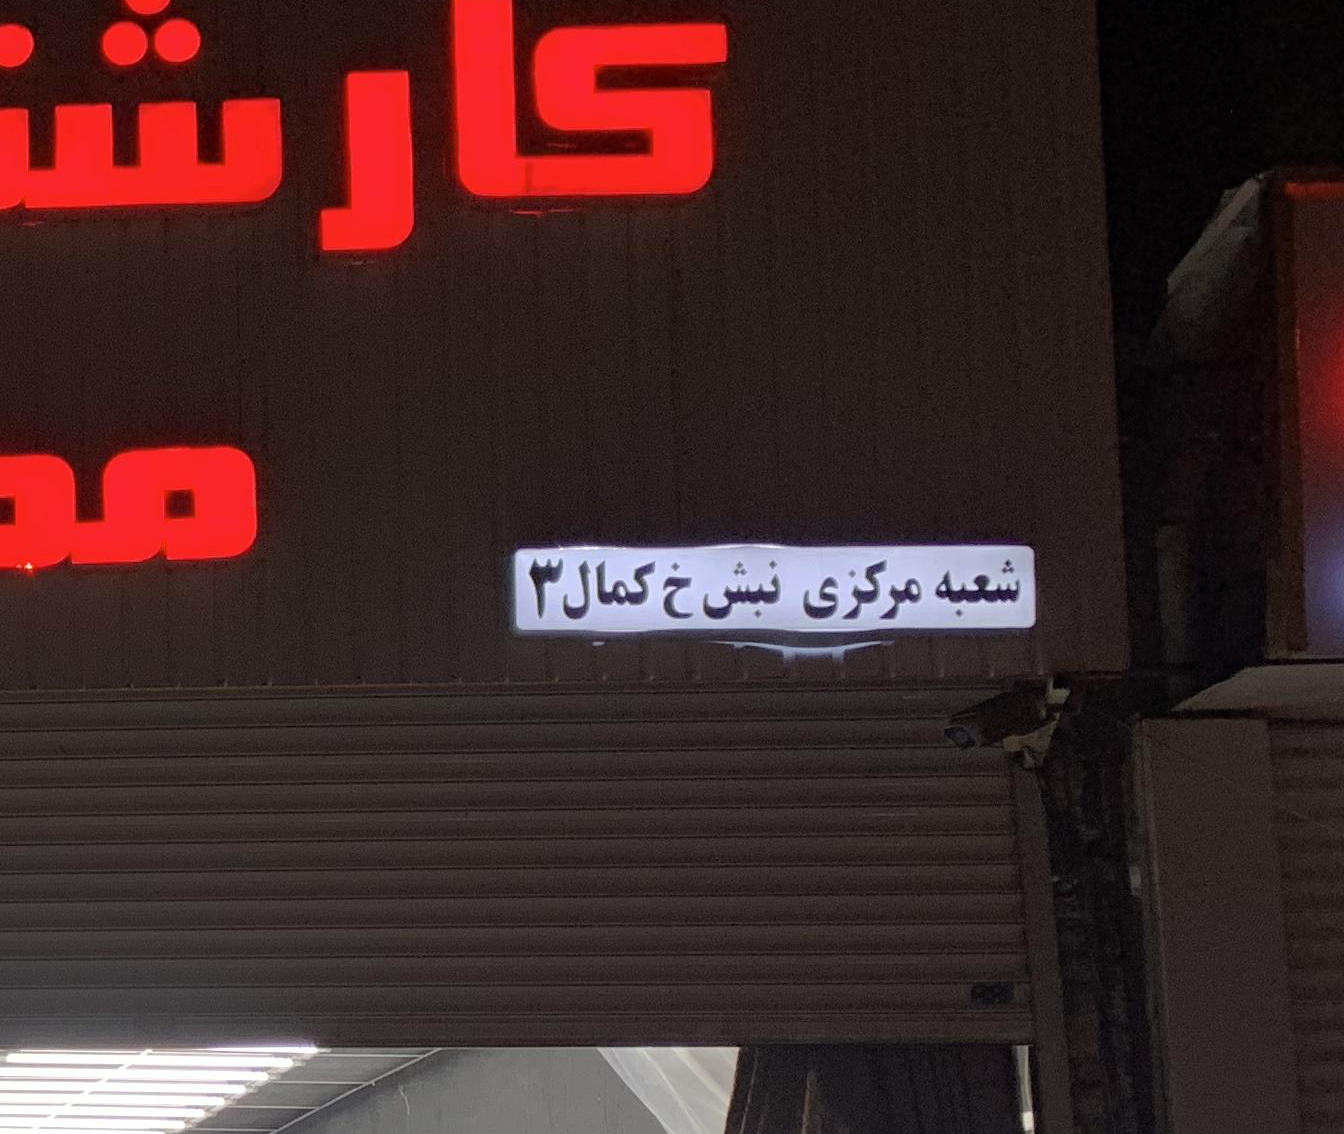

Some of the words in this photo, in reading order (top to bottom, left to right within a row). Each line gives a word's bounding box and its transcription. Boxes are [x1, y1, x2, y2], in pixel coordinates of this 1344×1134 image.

[662, 563, 693, 619] خ
[703, 560, 781, 620] نبش
[802, 560, 922, 620] مرکزی
[934, 558, 1021, 617] شعبه
